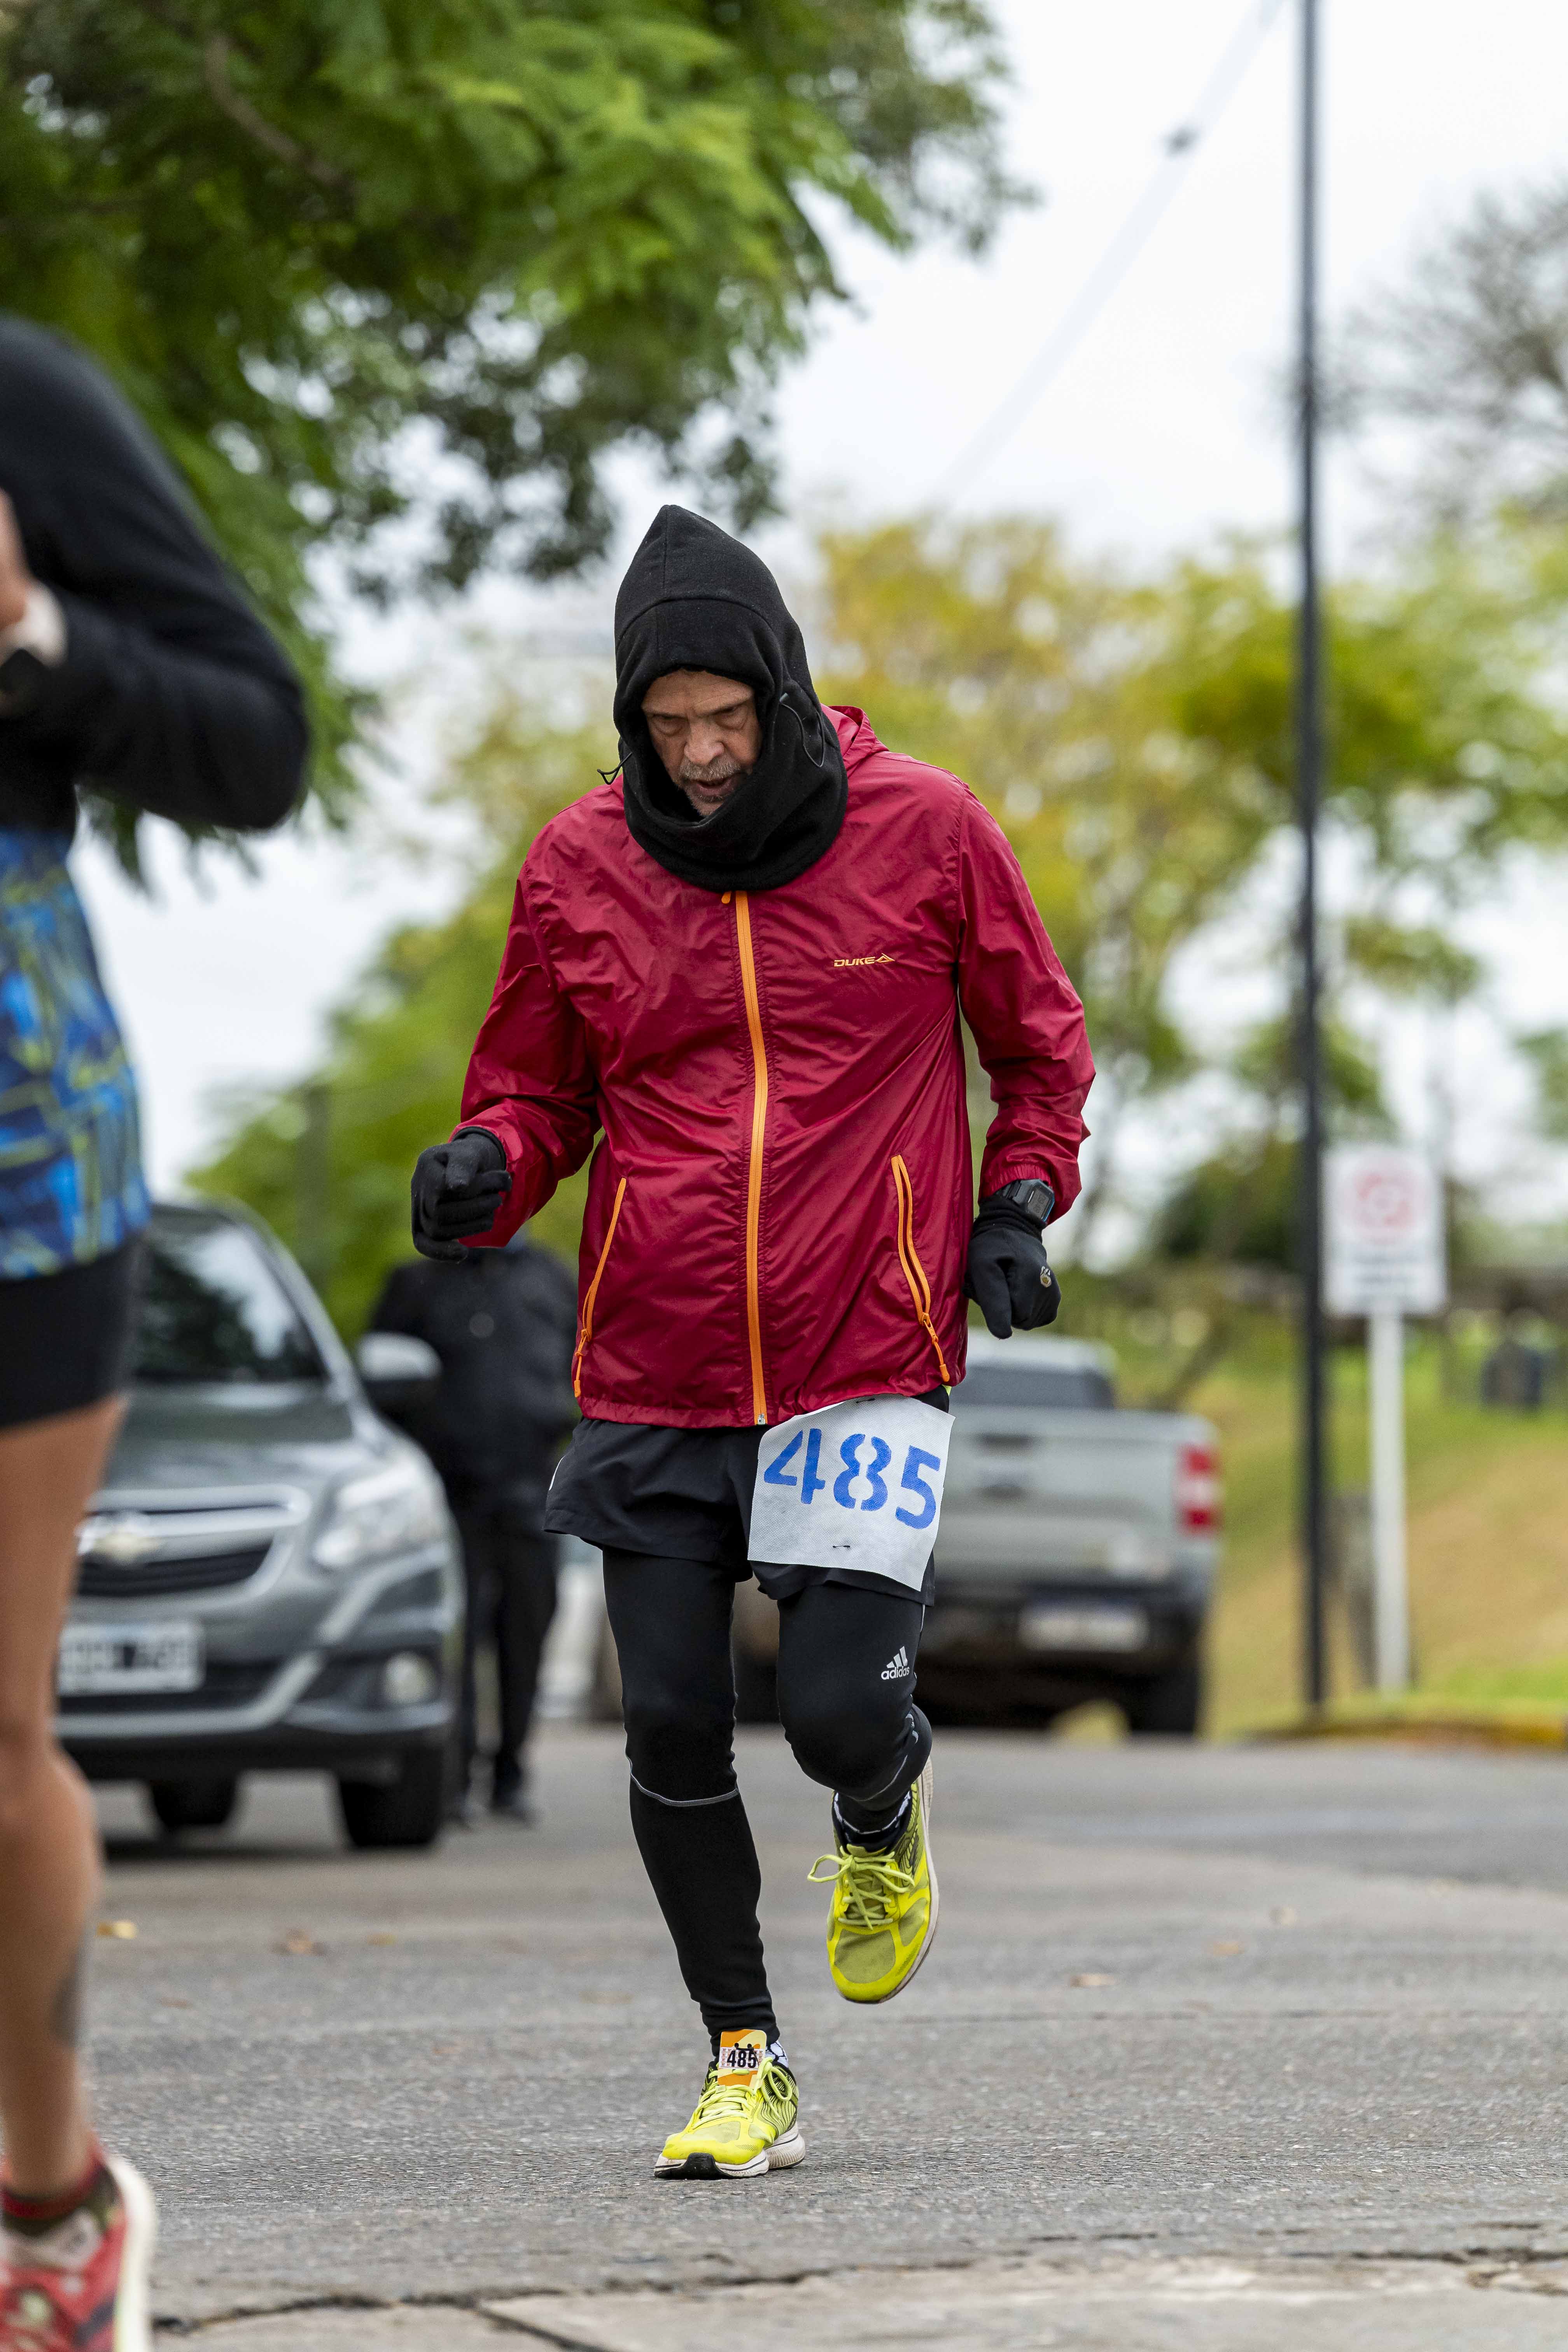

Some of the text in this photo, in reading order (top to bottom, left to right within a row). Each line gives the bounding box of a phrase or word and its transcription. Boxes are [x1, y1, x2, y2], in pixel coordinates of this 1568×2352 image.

[834, 956, 875, 967] DUKE
[764, 1428, 940, 1529] 485
[881, 1666, 910, 1680] adidas
[727, 2050, 757, 2068] 485
